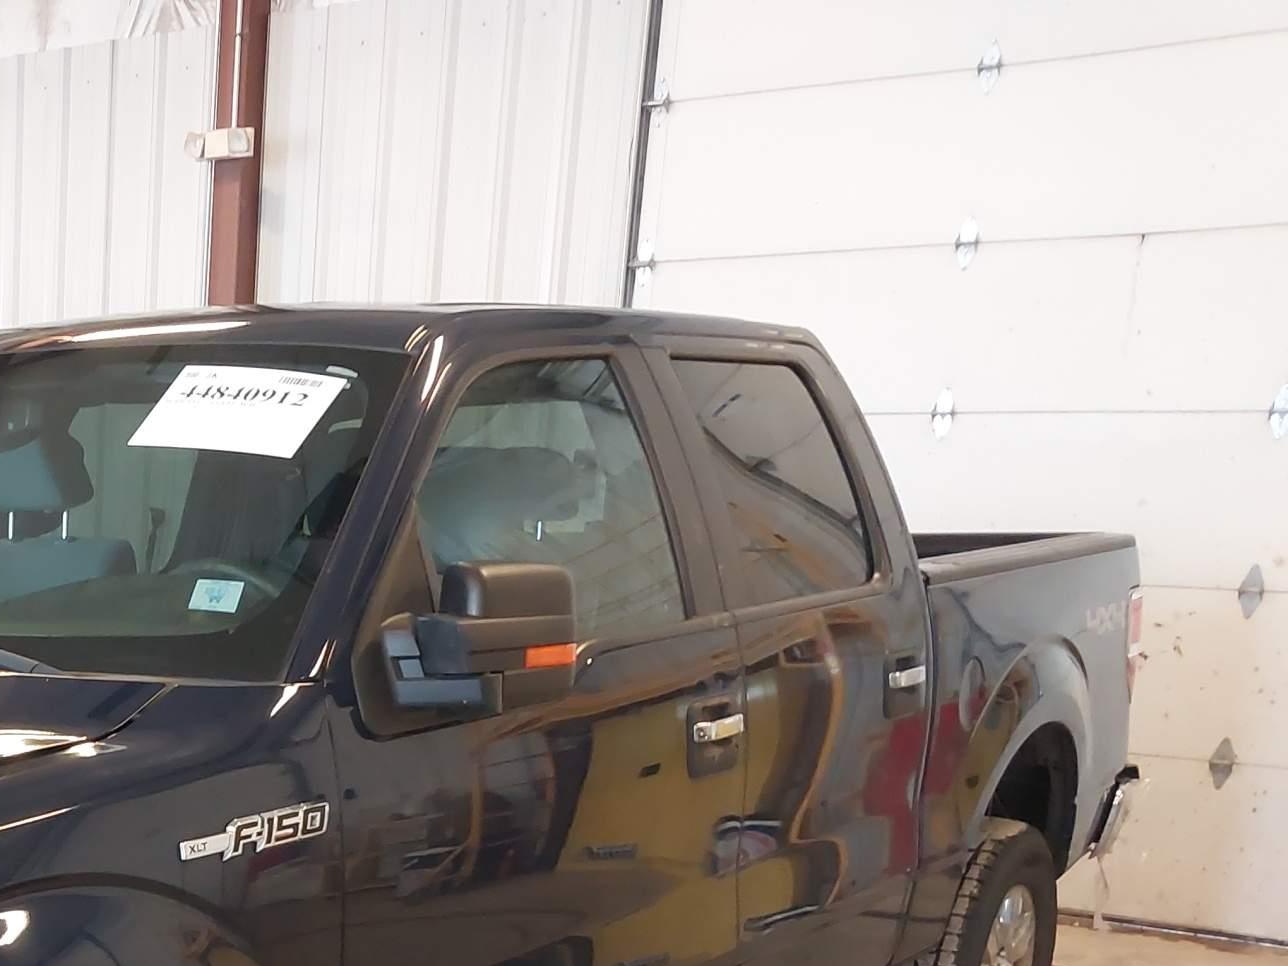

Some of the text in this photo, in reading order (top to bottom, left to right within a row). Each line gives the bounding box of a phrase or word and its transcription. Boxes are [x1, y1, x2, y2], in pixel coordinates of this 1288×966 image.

[179, 384, 309, 407] 44840912
[188, 802, 329, 860] XLT F-150
